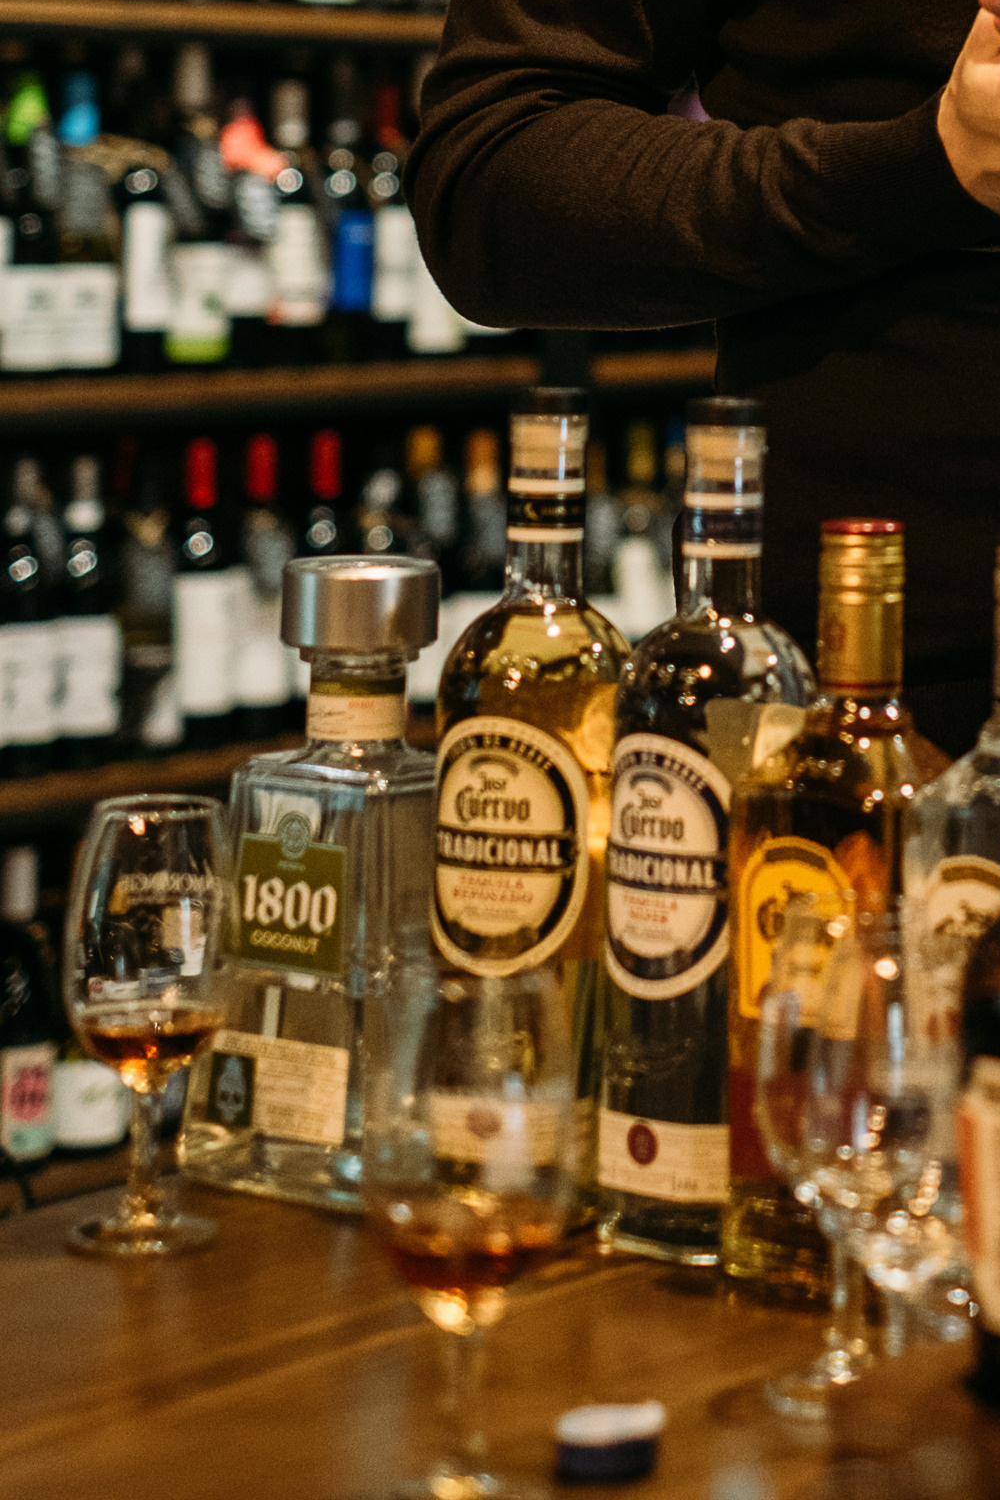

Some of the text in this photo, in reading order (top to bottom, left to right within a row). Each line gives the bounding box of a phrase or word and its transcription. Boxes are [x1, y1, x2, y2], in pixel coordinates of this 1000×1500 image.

[609, 848, 715, 889] RADICIONAL
[244, 874, 337, 934] 1800
[251, 929, 319, 955] COCONUT
